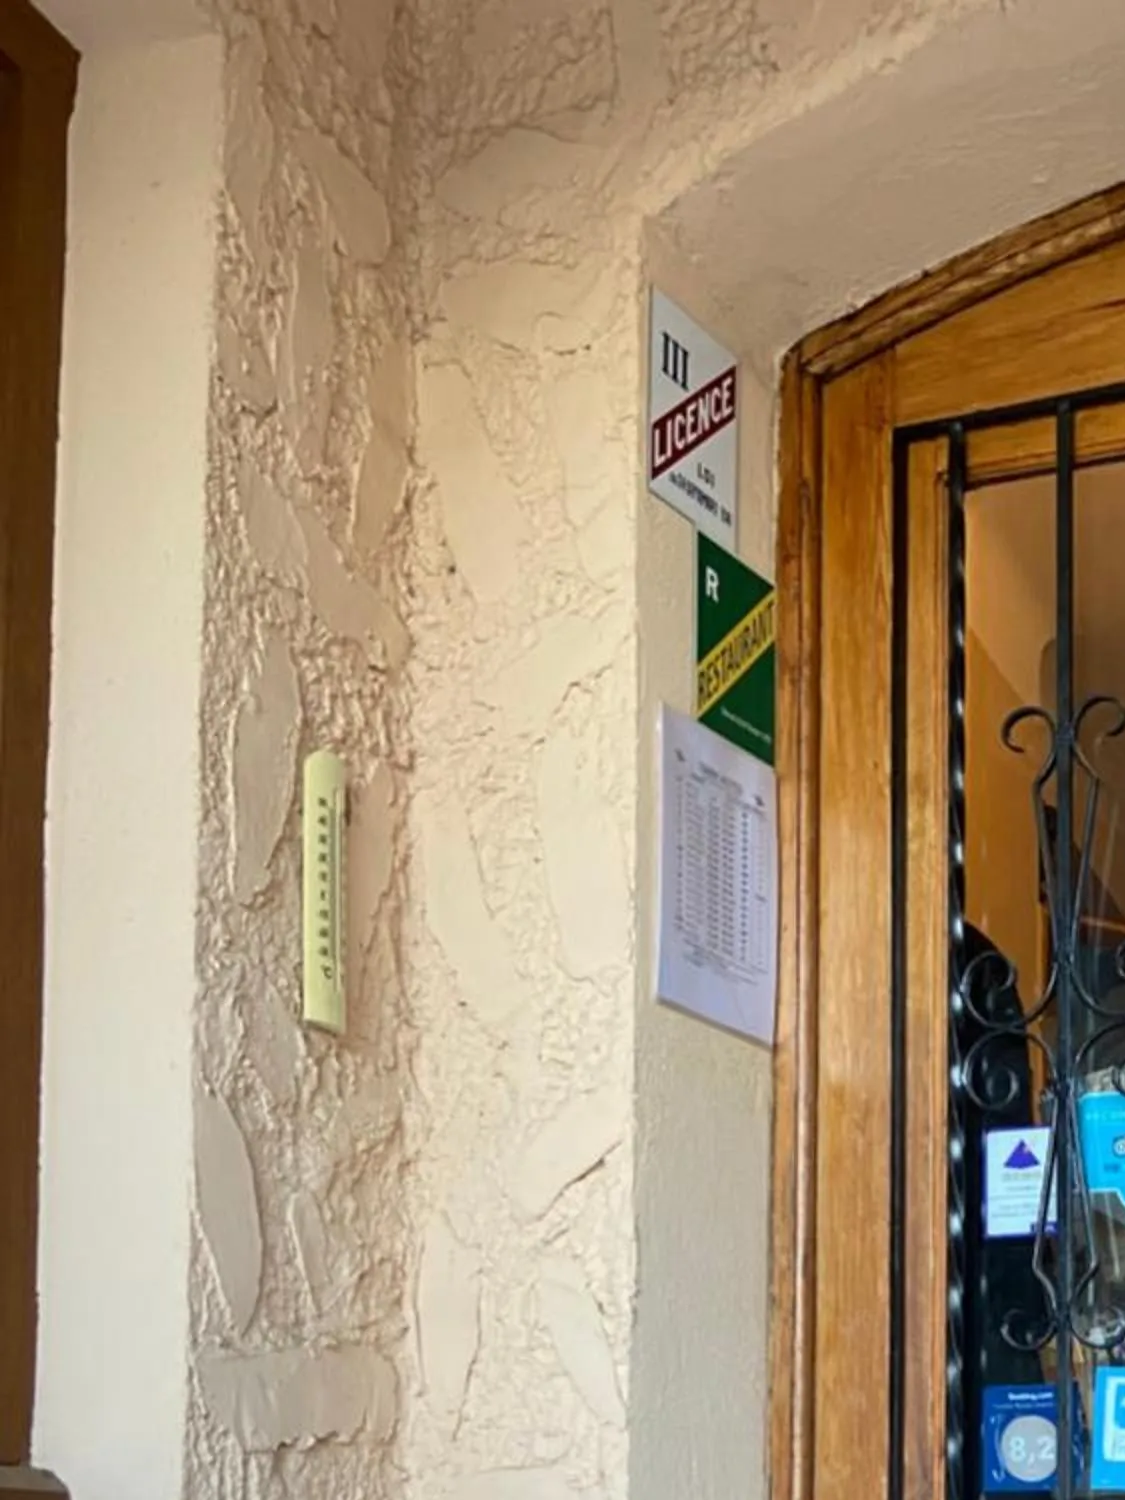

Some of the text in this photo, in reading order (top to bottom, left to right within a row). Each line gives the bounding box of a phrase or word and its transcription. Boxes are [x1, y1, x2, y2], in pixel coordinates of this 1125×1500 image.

[653, 376, 735, 468] LICENCE
[705, 565, 720, 604] R
[698, 599, 775, 712] RESTAURANT
[1009, 1435, 1056, 1465] 8,2
